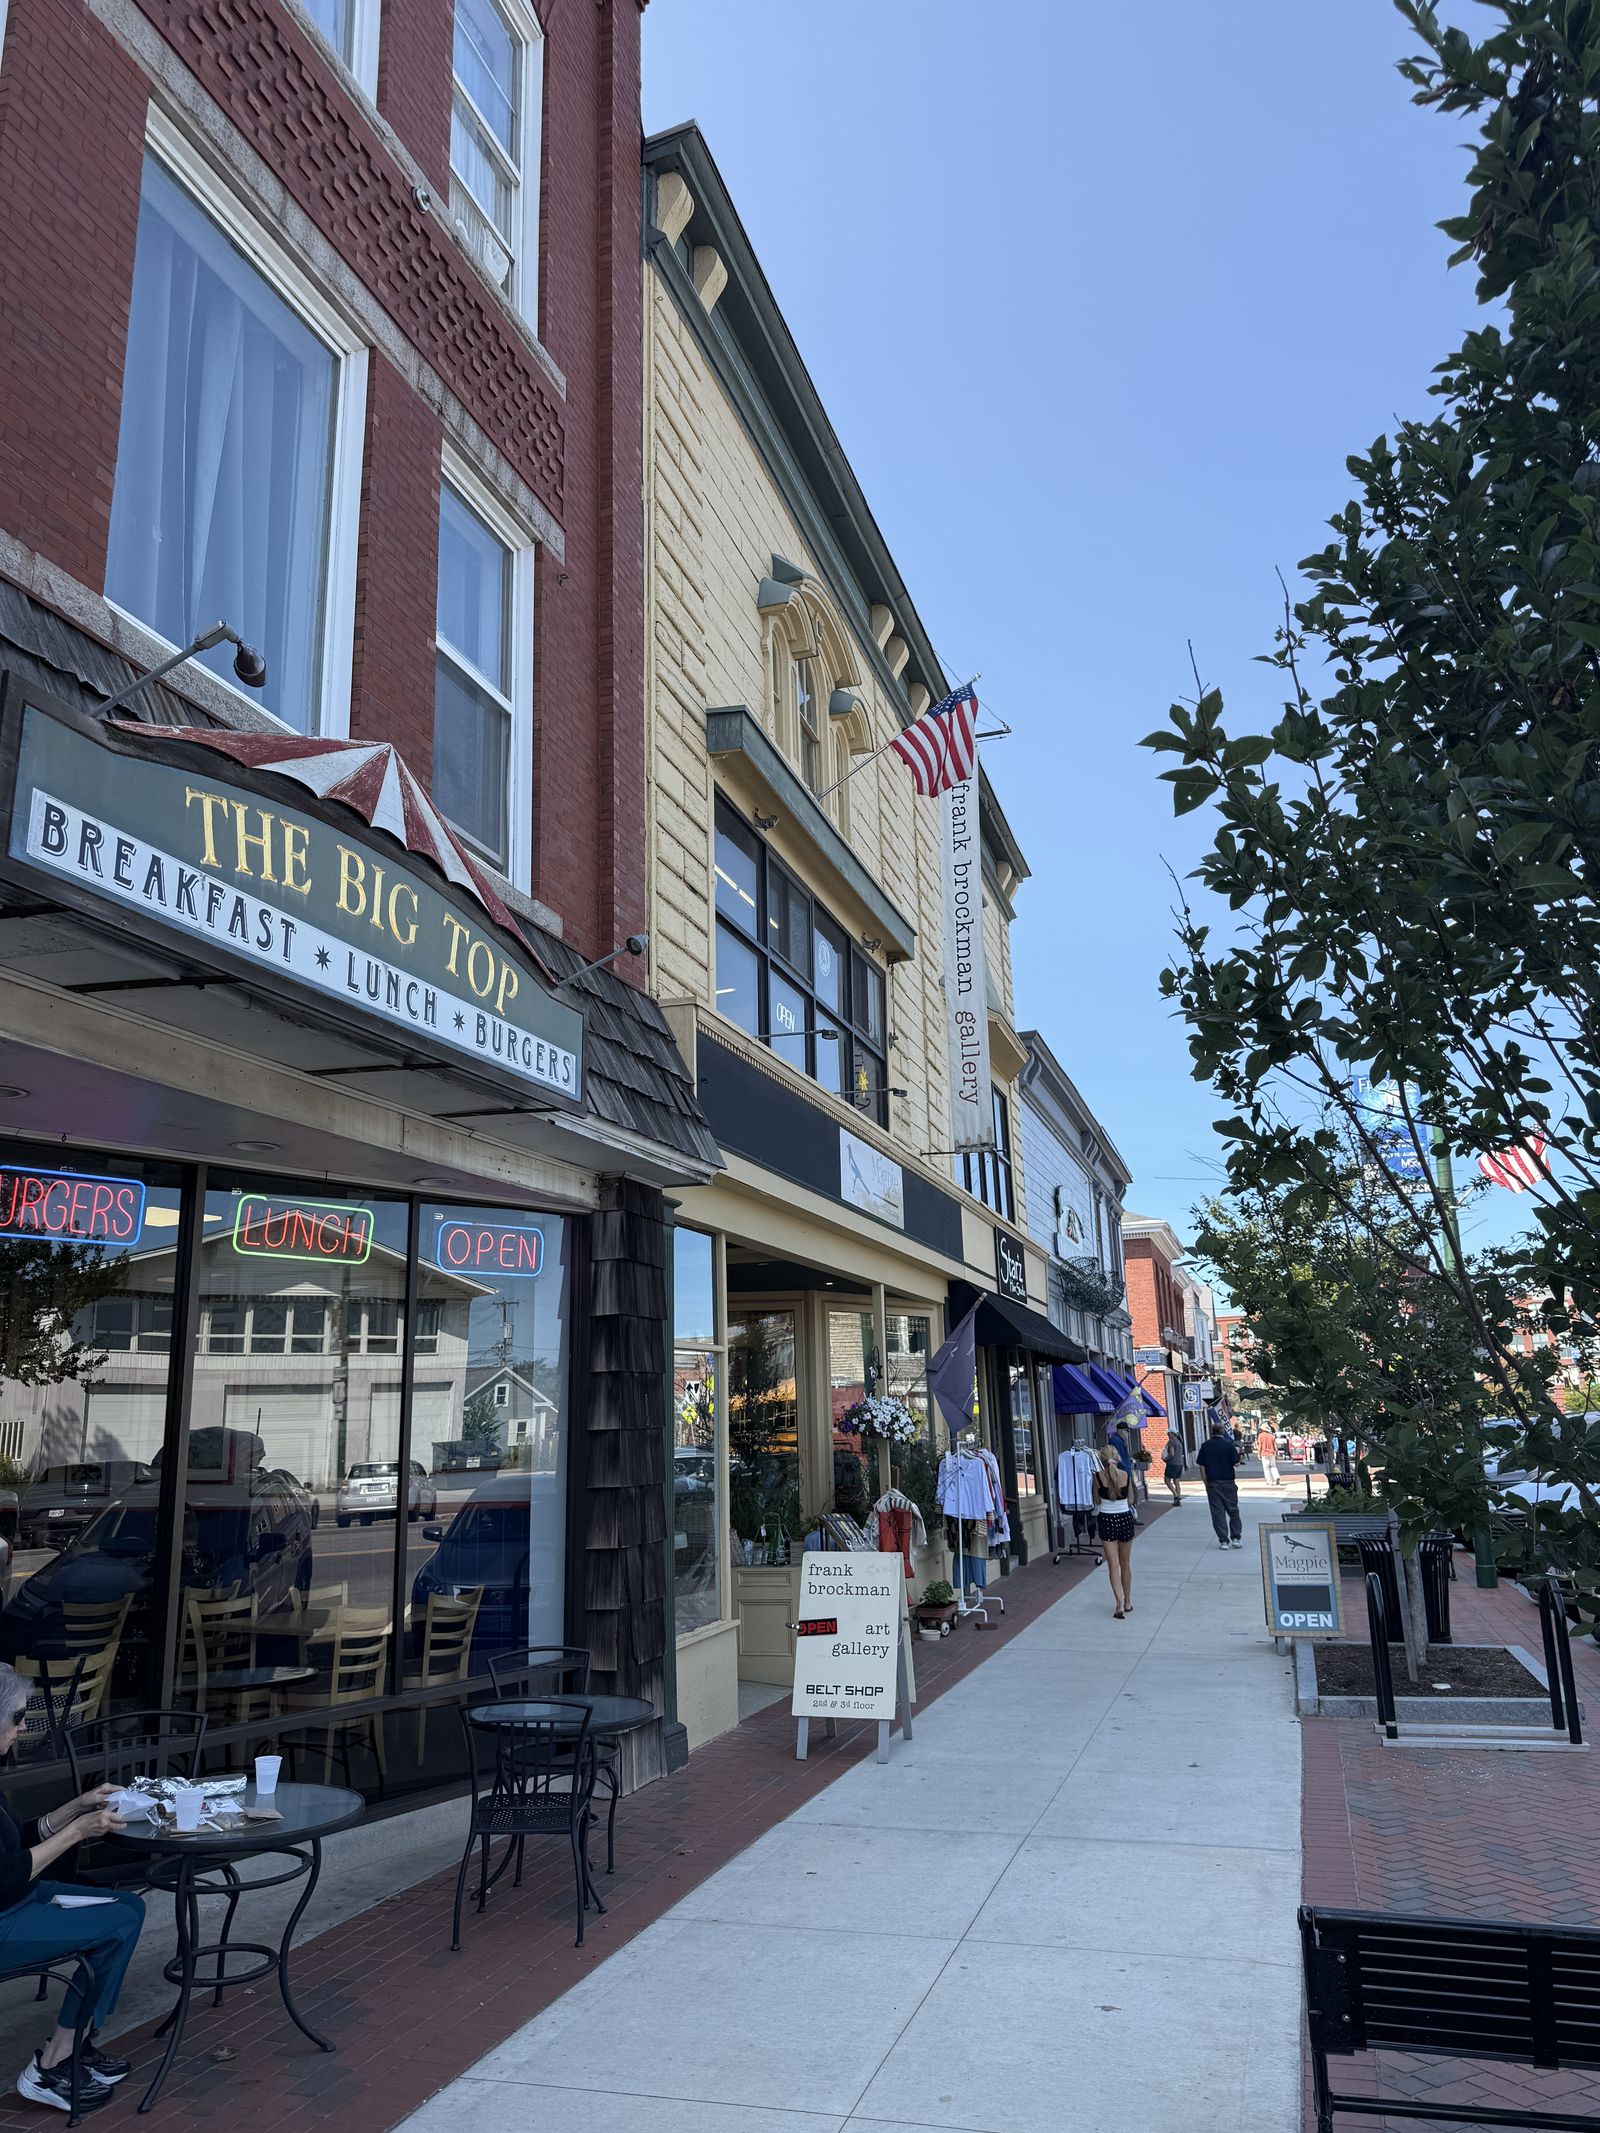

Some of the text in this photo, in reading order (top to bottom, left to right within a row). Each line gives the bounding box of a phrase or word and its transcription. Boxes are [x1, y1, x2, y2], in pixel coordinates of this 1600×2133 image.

[185, 785, 519, 1016] THE BIG TOP
[40, 801, 573, 1087] BREAKFAST LUNCH BURGERS
[951, 782, 981, 1107] frank brockman gallery
[776, 1002, 796, 1032] OPEN
[871, 1155, 899, 1198] Magpie
[0, 1174, 134, 1237] URGERS
[242, 1204, 367, 1255] LUNCH
[446, 1229, 538, 1270] OPEN
[808, 1564, 853, 1576] frank
[1275, 1555, 1327, 1572] Magpie
[808, 1582, 891, 1596] brockman
[799, 1621, 836, 1635] OPEN
[1280, 1613, 1333, 1627] OPEN
[865, 1623, 890, 1635] art
[832, 1642, 890, 1659] gallery
[806, 1684, 884, 1696] BELT SHOP
[830, 1700, 838, 1709] &
[853, 1701, 875, 1710] floor
